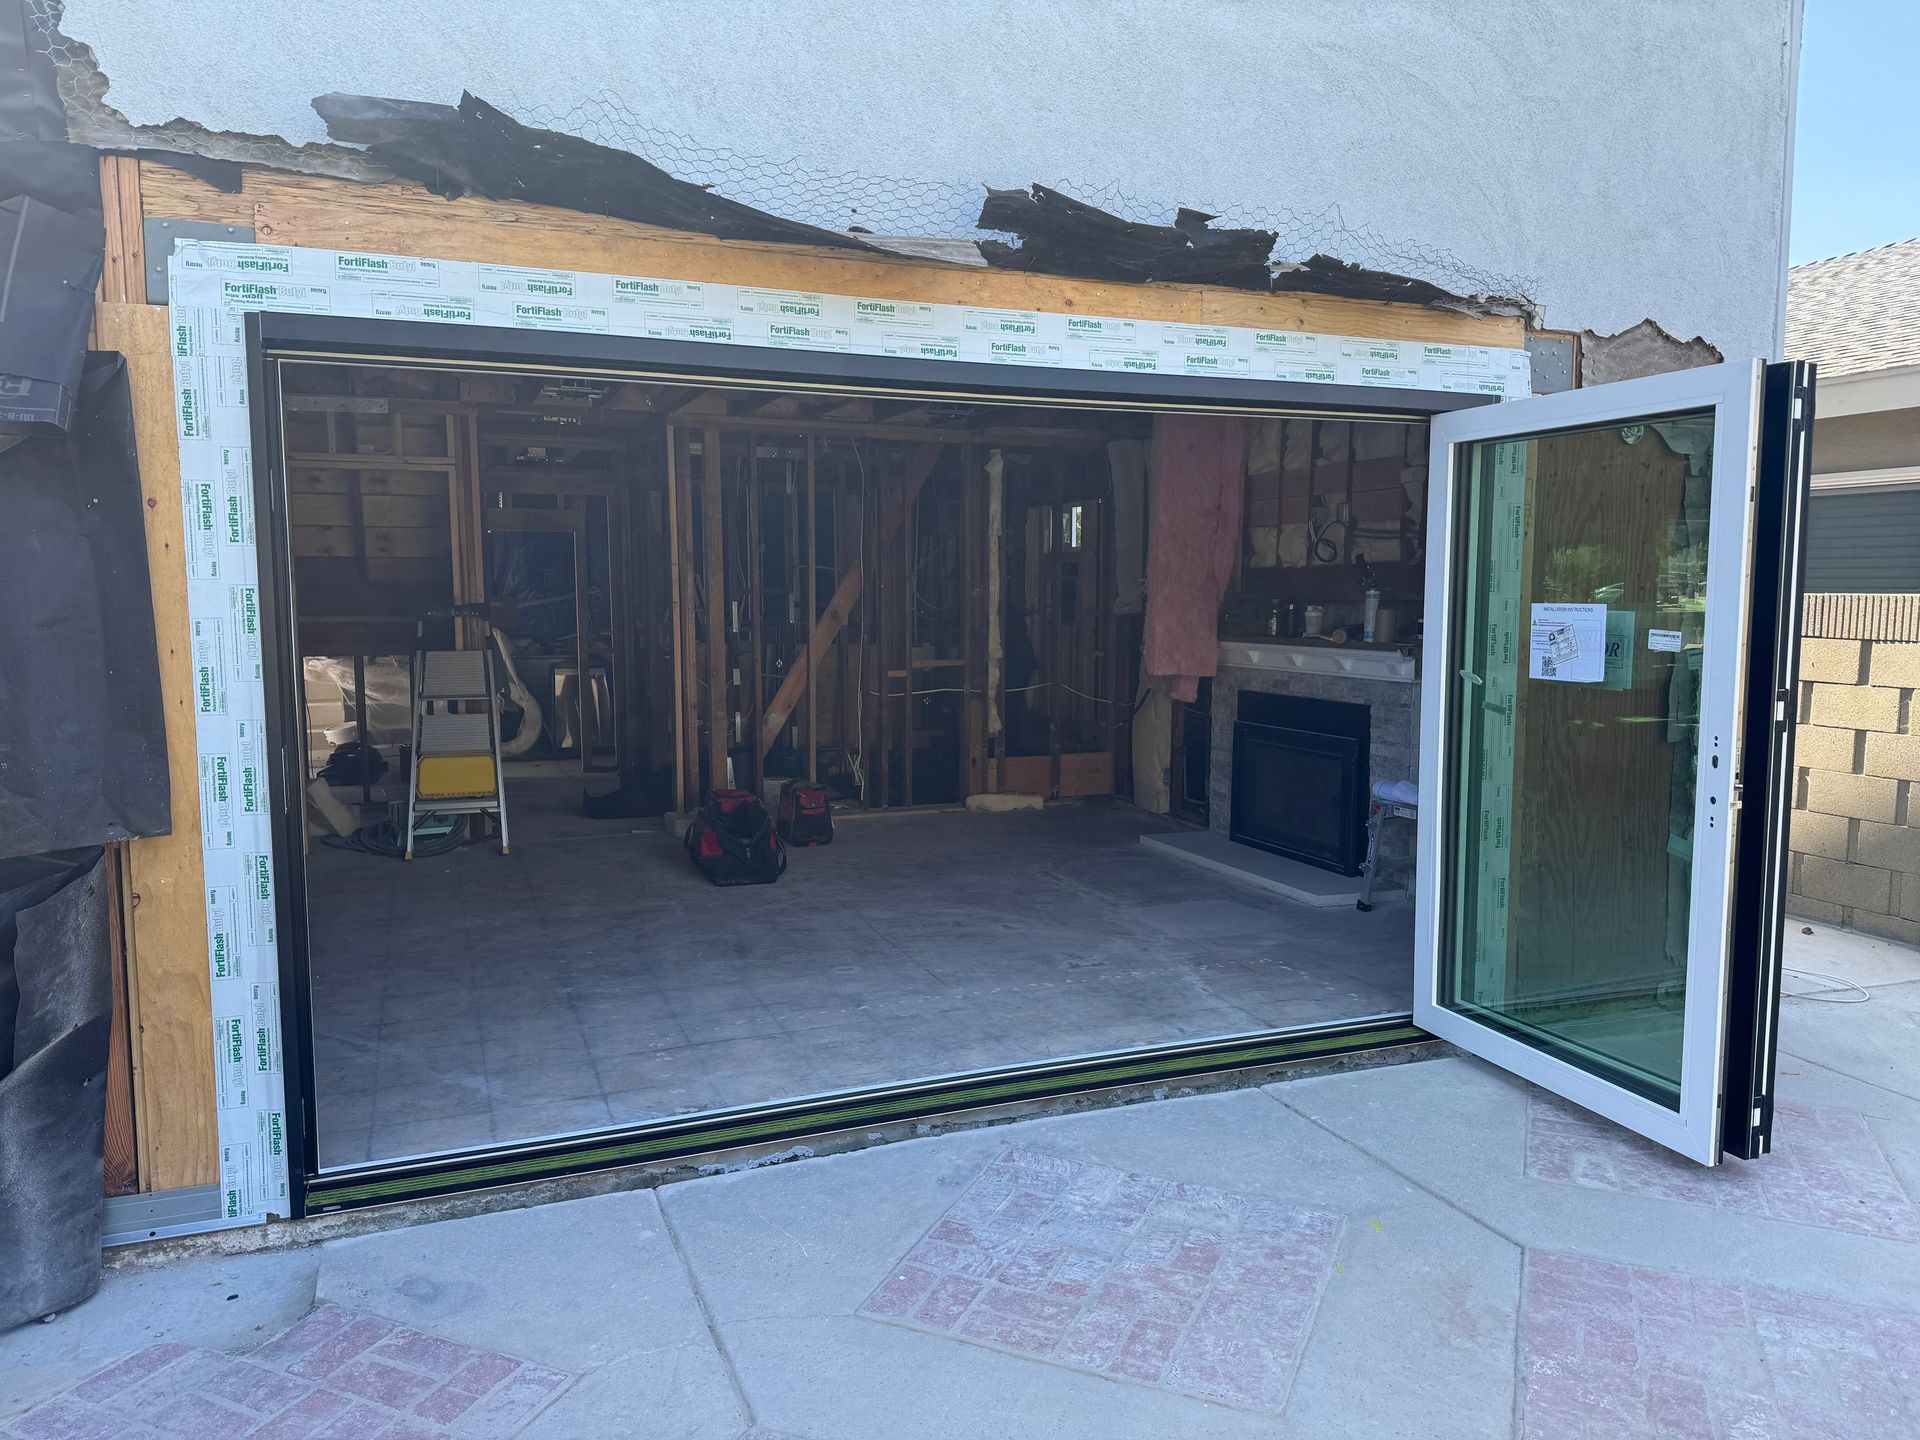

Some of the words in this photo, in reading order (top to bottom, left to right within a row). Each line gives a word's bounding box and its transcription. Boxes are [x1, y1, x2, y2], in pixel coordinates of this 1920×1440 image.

[186, 260, 202, 268] Henry
[207, 256, 235, 269] Butyl
[238, 260, 289, 272] FortiFlash
[338, 256, 388, 269] FortiFlash
[390, 260, 416, 272] Butyl
[420, 261, 436, 269] Henry
[225, 282, 276, 295] FortiFlash
[278, 286, 306, 299] Butyl
[501, 280, 525, 292] Butyl
[527, 283, 573, 296] FortiFlash
[616, 280, 659, 292] FortiFlash
[660, 283, 683, 295] Butyl
[376, 308, 392, 316] Henry
[396, 305, 422, 316] Butyl
[424, 308, 471, 320] FortiFlash
[516, 304, 562, 317] FortiFlash
[563, 308, 587, 320] Butyl
[780, 305, 820, 317] FortiFlash
[857, 302, 895, 313] FortiFlash
[666, 325, 689, 337] Butyl
[770, 324, 810, 337] FortiFlash
[1000, 323, 1035, 334] FortiFlash
[1068, 319, 1102, 329] FortiFlash
[690, 328, 731, 340] FortiFlash
[1256, 333, 1287, 342] FortiFlash
[991, 342, 1026, 353] FortiFlash
[1195, 337, 1227, 348] FortiFlash
[1424, 346, 1452, 355] FortiFlash
[920, 347, 957, 358] FortiFlash
[1187, 356, 1218, 365] FortiFlash
[1369, 351, 1398, 360] FortiFlash
[180, 360, 191, 387] Butyl
[232, 359, 243, 385] Butyl
[1124, 361, 1156, 371] FortiFlash
[1362, 368, 1390, 377] FortiFlash
[1305, 372, 1335, 381] FortiFlash
[1478, 384, 1505, 393] FortiFlash
[182, 389, 194, 437] FortiFlash
[225, 469, 238, 494] Butyl
[201, 484, 213, 531] FortiFlash
[228, 496, 239, 543] FortiFlash
[203, 531, 215, 558] Butyl
[245, 588, 256, 634] FortiFlash
[197, 640, 210, 665] Butyl
[247, 636, 260, 660] Butyl
[199, 667, 211, 713] FortiFlash
[241, 741, 253, 766] Butyl
[217, 756, 228, 802] FortiFlash
[243, 767, 254, 812] FortiFlash
[218, 803, 230, 828] Butyl
[259, 855, 270, 900] FortiFlash
[212, 908, 224, 932] Butyl
[260, 900, 273, 924] Butyl
[214, 933, 225, 978] FortiFlash
[255, 1002, 266, 1026] Butyl
[231, 1019, 243, 1063] FortiFlash
[257, 1028, 267, 1071] FortiFlash
[232, 1063, 245, 1088] Butyl
[272, 1112, 283, 1155] FortiFlash
[273, 1156, 284, 1179] Butyl
[226, 1165, 238, 1189] Butyl
